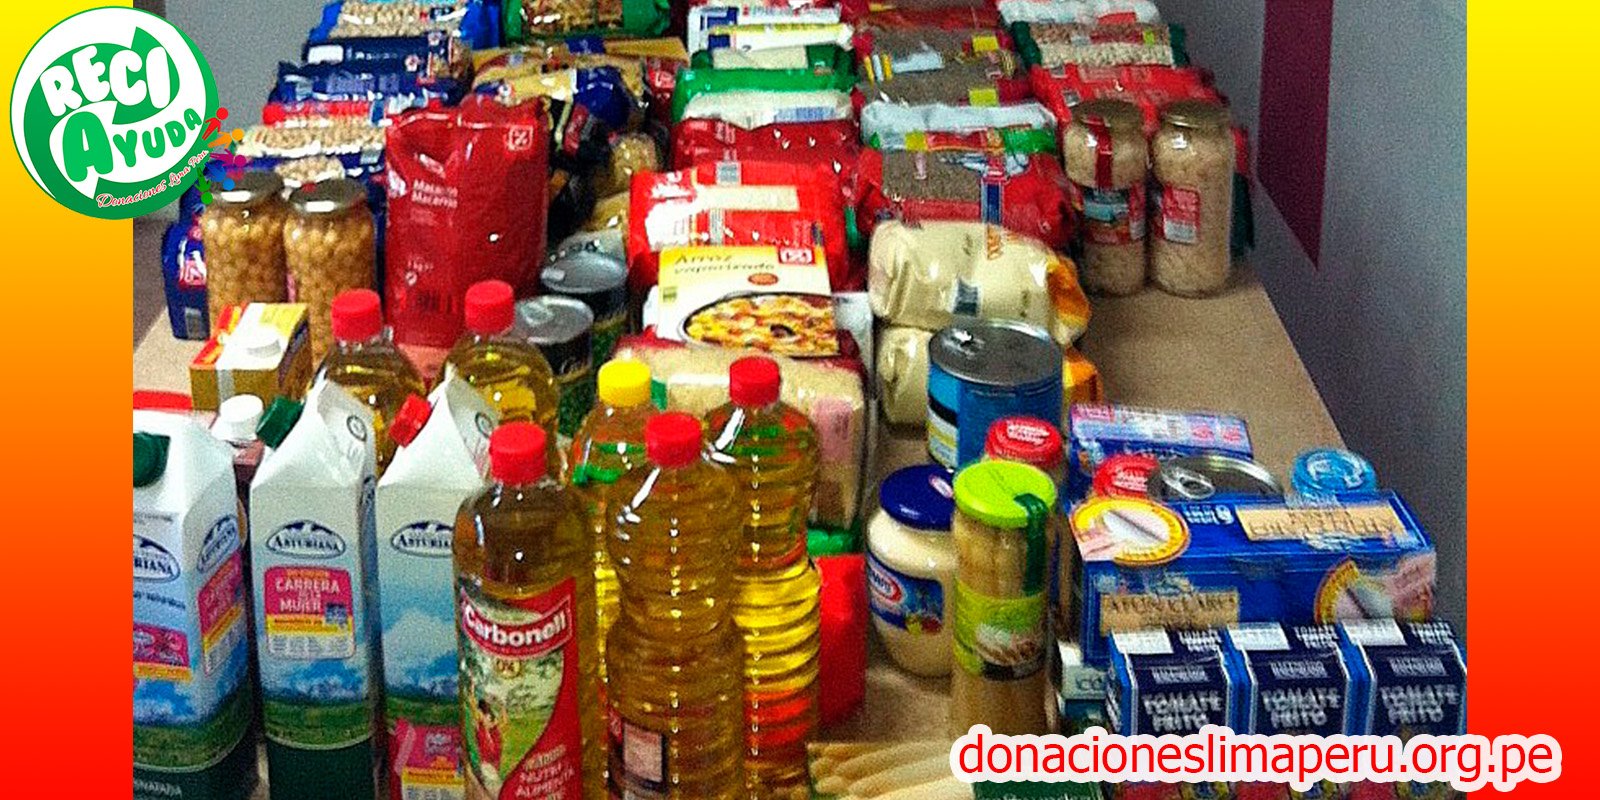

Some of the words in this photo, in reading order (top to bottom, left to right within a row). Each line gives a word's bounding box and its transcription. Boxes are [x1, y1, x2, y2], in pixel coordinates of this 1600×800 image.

[273, 534, 340, 553] ASTURIANA
[275, 578, 340, 595] CARRERA
[463, 602, 568, 648] Carbonell
